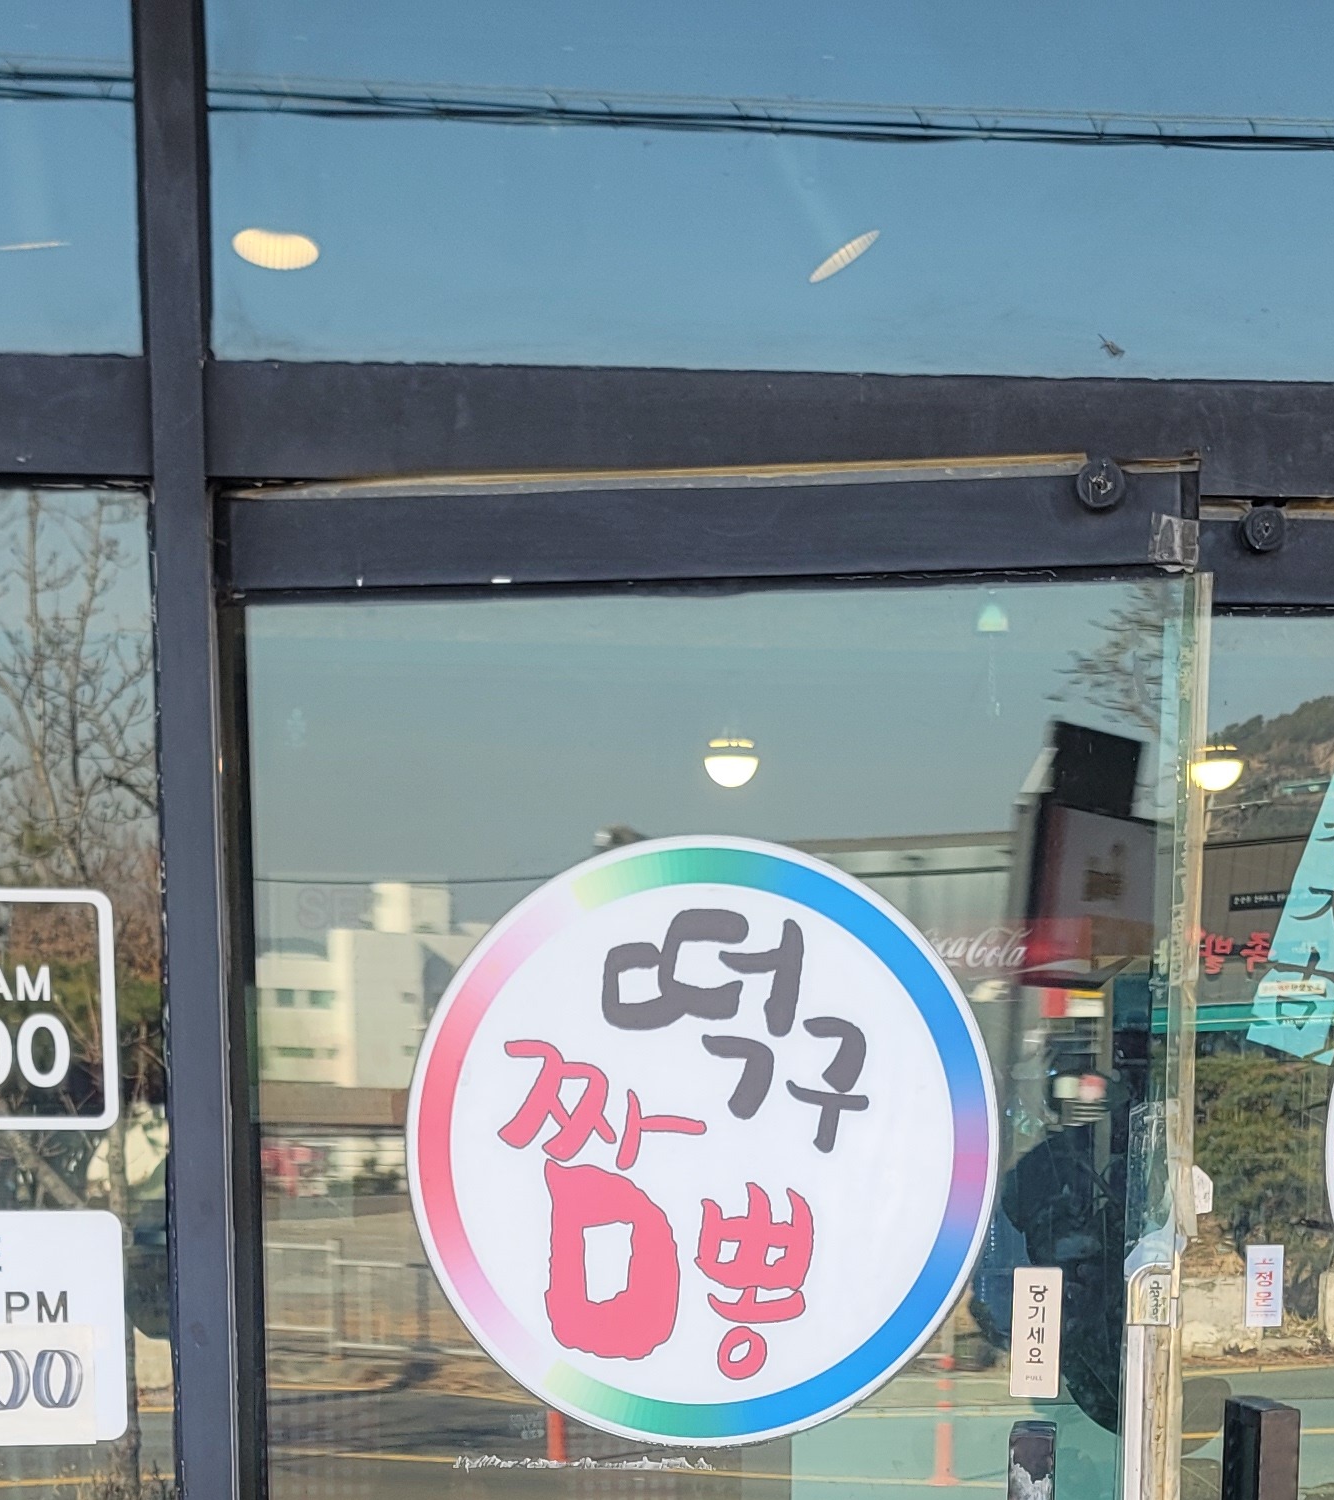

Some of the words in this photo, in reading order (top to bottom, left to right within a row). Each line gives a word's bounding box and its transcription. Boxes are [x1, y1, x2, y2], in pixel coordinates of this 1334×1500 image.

[497, 1038, 814, 1381] 짬뽕
[4, 1289, 70, 1325] PM
[1024, 1284, 1049, 1365] 당기세요
[1025, 1374, 1043, 1382] PULL
